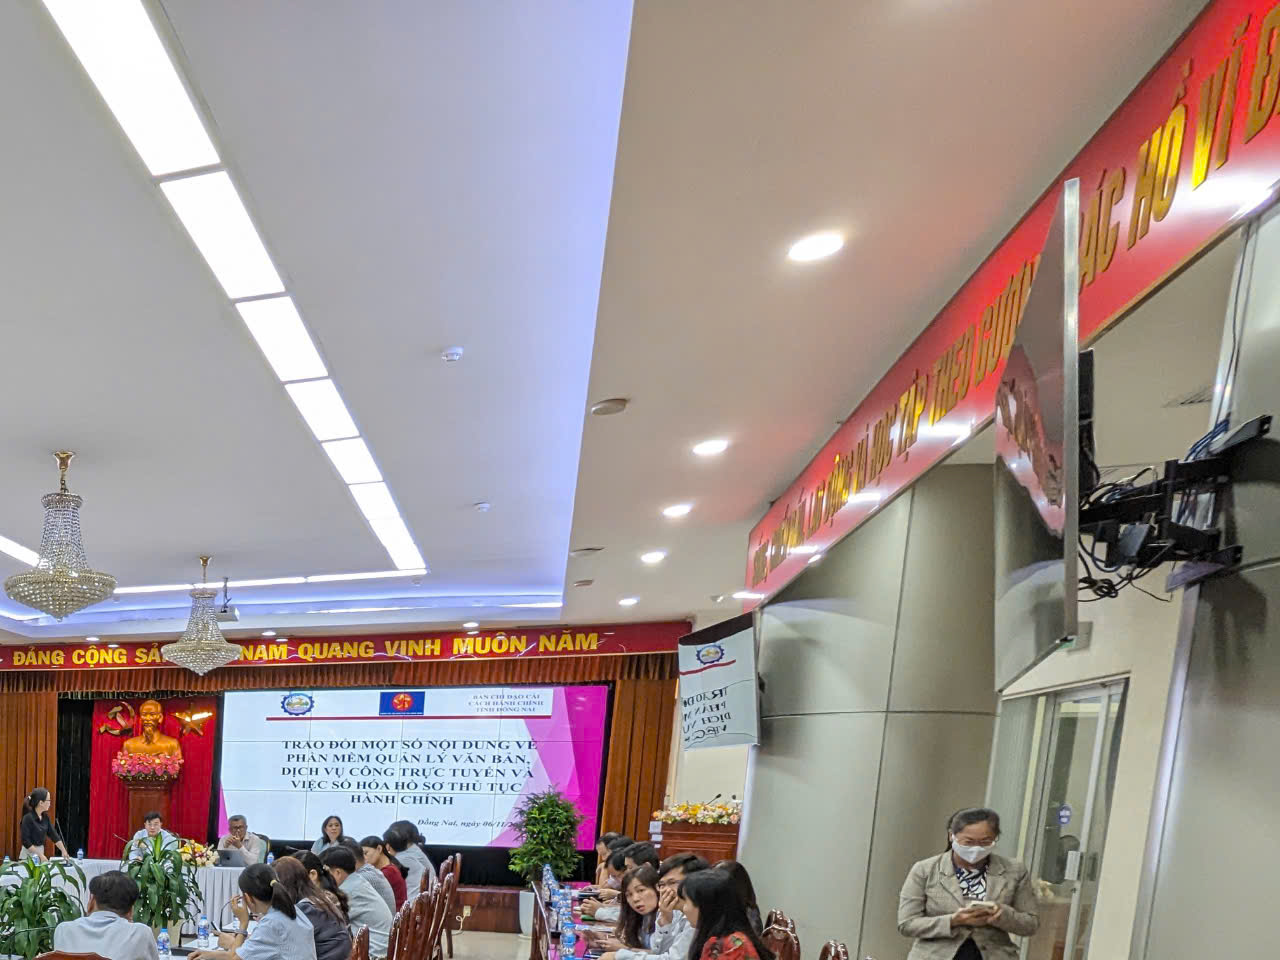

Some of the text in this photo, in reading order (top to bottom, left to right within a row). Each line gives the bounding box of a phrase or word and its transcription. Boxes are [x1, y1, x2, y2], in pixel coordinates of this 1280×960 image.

[897, 368, 929, 463] TẬP
[929, 323, 975, 427] THEO
[1079, 167, 1126, 296] ÁC
[12, 645, 65, 666] ĐẢNG
[71, 644, 128, 668] CỘNG
[240, 643, 288, 661] NAM
[297, 640, 375, 662] QUANG
[384, 638, 441, 656] VINH
[452, 631, 527, 655] MUÔN
[538, 630, 599, 652] NĂM
[282, 740, 324, 750] TRAO
[361, 738, 399, 751] MỘT
[401, 737, 423, 750] SỐ
[427, 738, 457, 751] NỘI
[462, 740, 510, 750] DUNG
[426, 751, 448, 764] LÝ
[452, 752, 486, 764] VĂN
[281, 765, 534, 779] DỊCH VỤ CÔNG TRỰC TUYẾN VÀ
[291, 779, 328, 791] VIỆC
[331, 778, 352, 790] SỐ
[356, 778, 390, 790] HÓA
[422, 781, 445, 791] SƠ
[487, 783, 522, 794] TỤC
[351, 792, 453, 805] HÀNH CHÍNH
